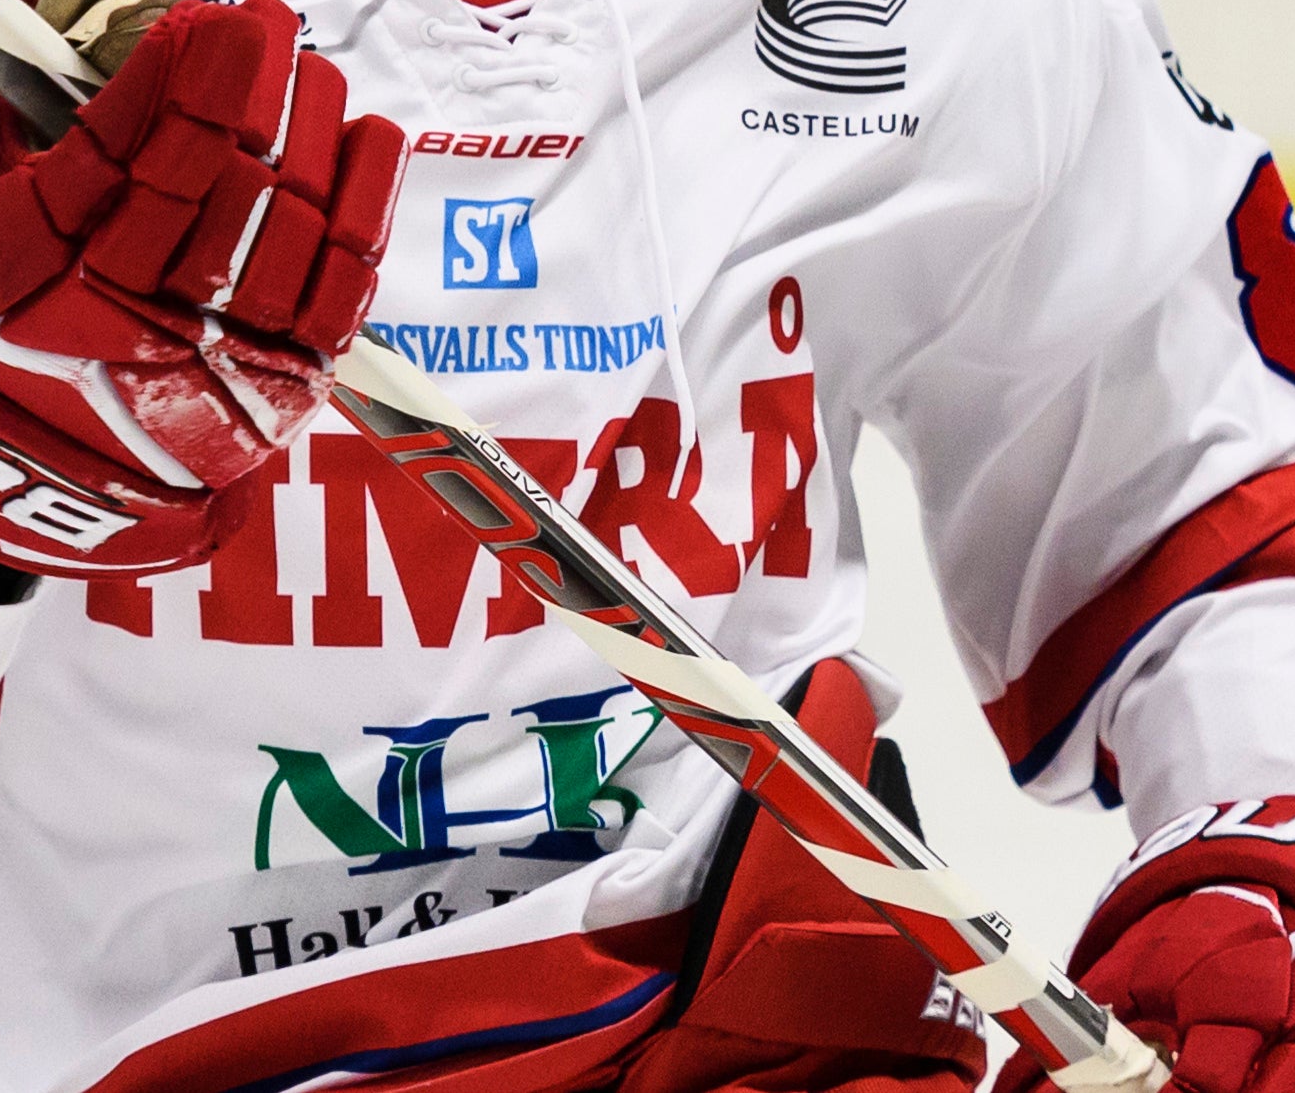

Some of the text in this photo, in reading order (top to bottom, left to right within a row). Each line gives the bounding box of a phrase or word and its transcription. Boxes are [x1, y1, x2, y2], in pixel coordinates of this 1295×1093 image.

[740, 108, 920, 138] CASTELLUM
[452, 204, 530, 284] ST
[86, 275, 818, 649] IMRÅ
